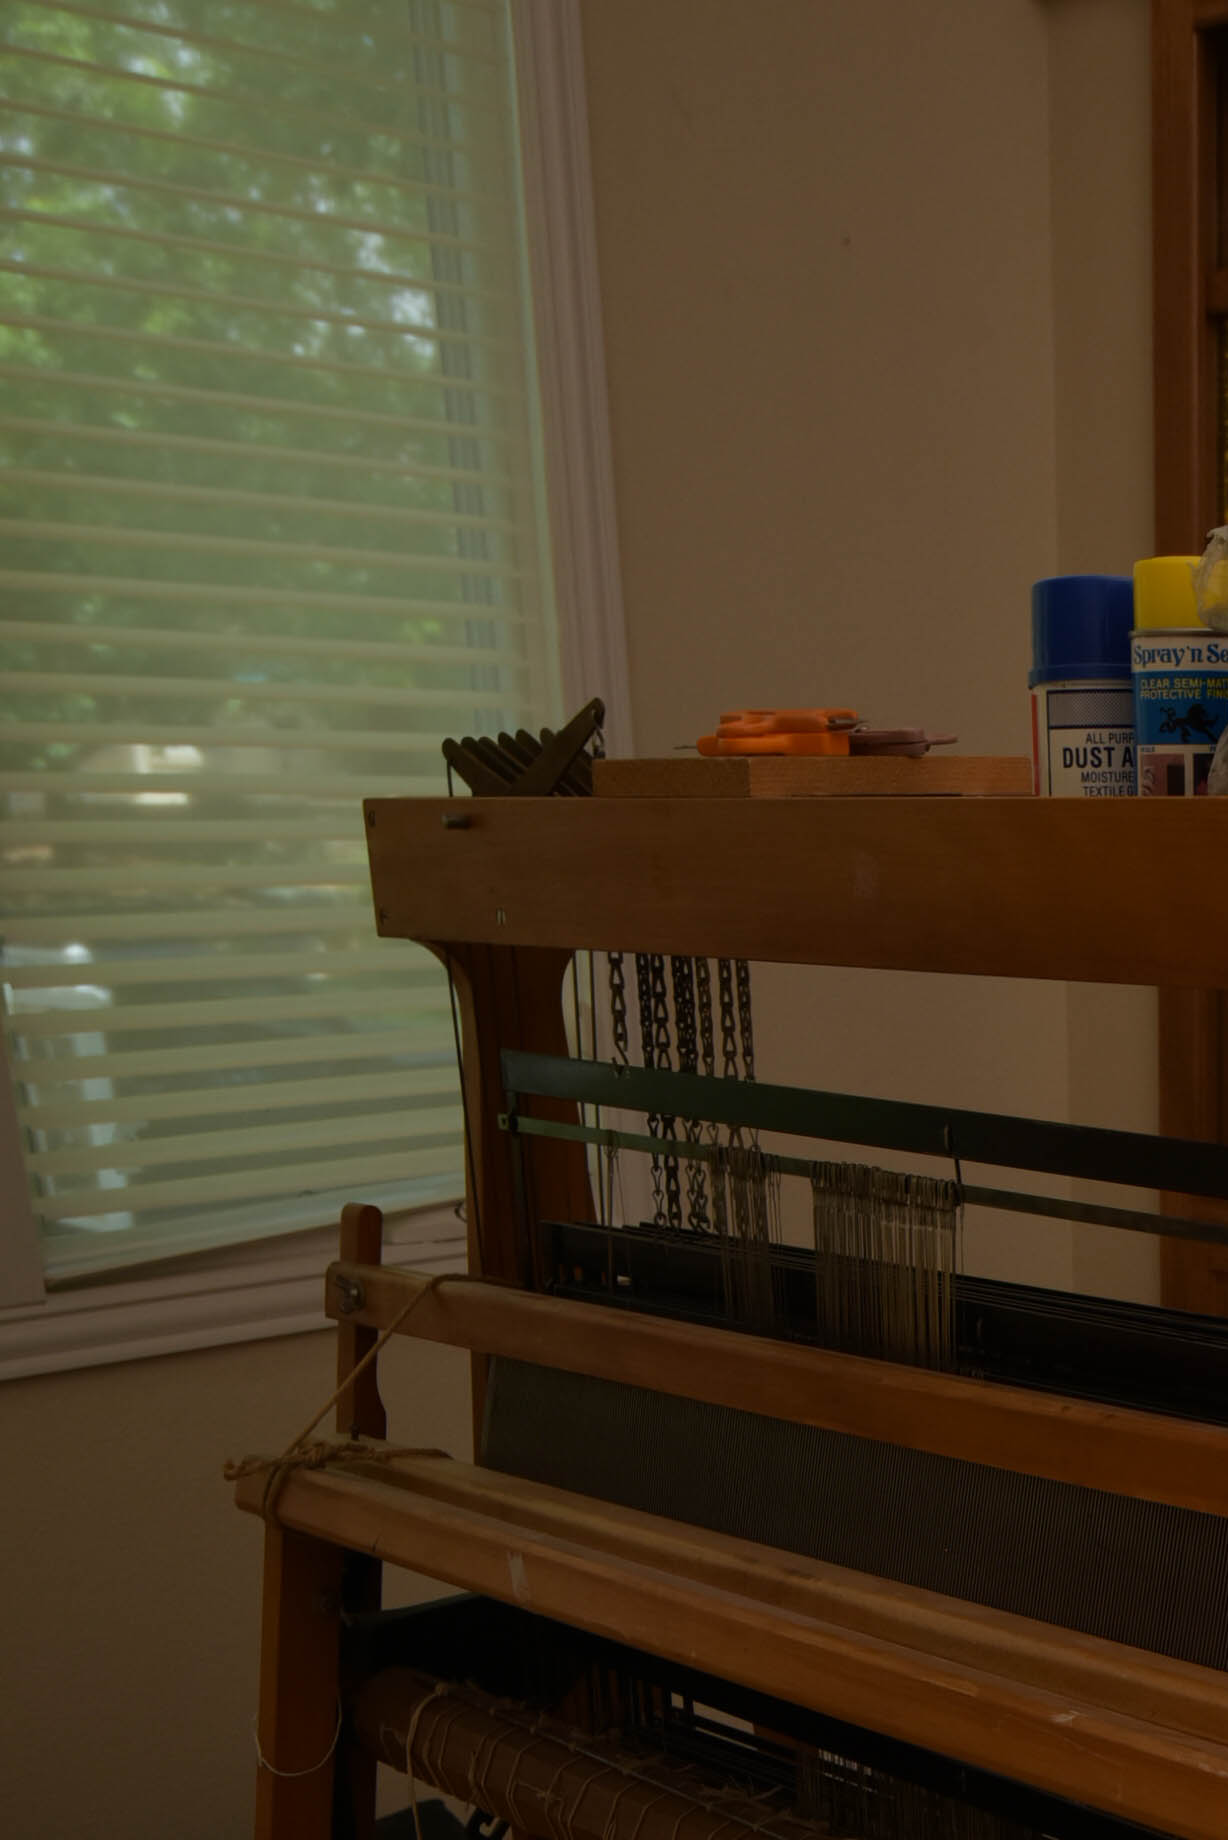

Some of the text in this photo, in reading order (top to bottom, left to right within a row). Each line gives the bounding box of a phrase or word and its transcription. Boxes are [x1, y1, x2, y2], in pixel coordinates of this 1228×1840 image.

[1133, 645, 1203, 667] Spray'n
[1140, 677, 1170, 690] CLEAR
[1139, 688, 1202, 700] PROTECTIVE
[1085, 733, 1104, 745] ALL
[1062, 747, 1135, 769] DUST A
[1081, 771, 1136, 784] MOISTURE
[1083, 785, 1126, 797] TEXTILE
